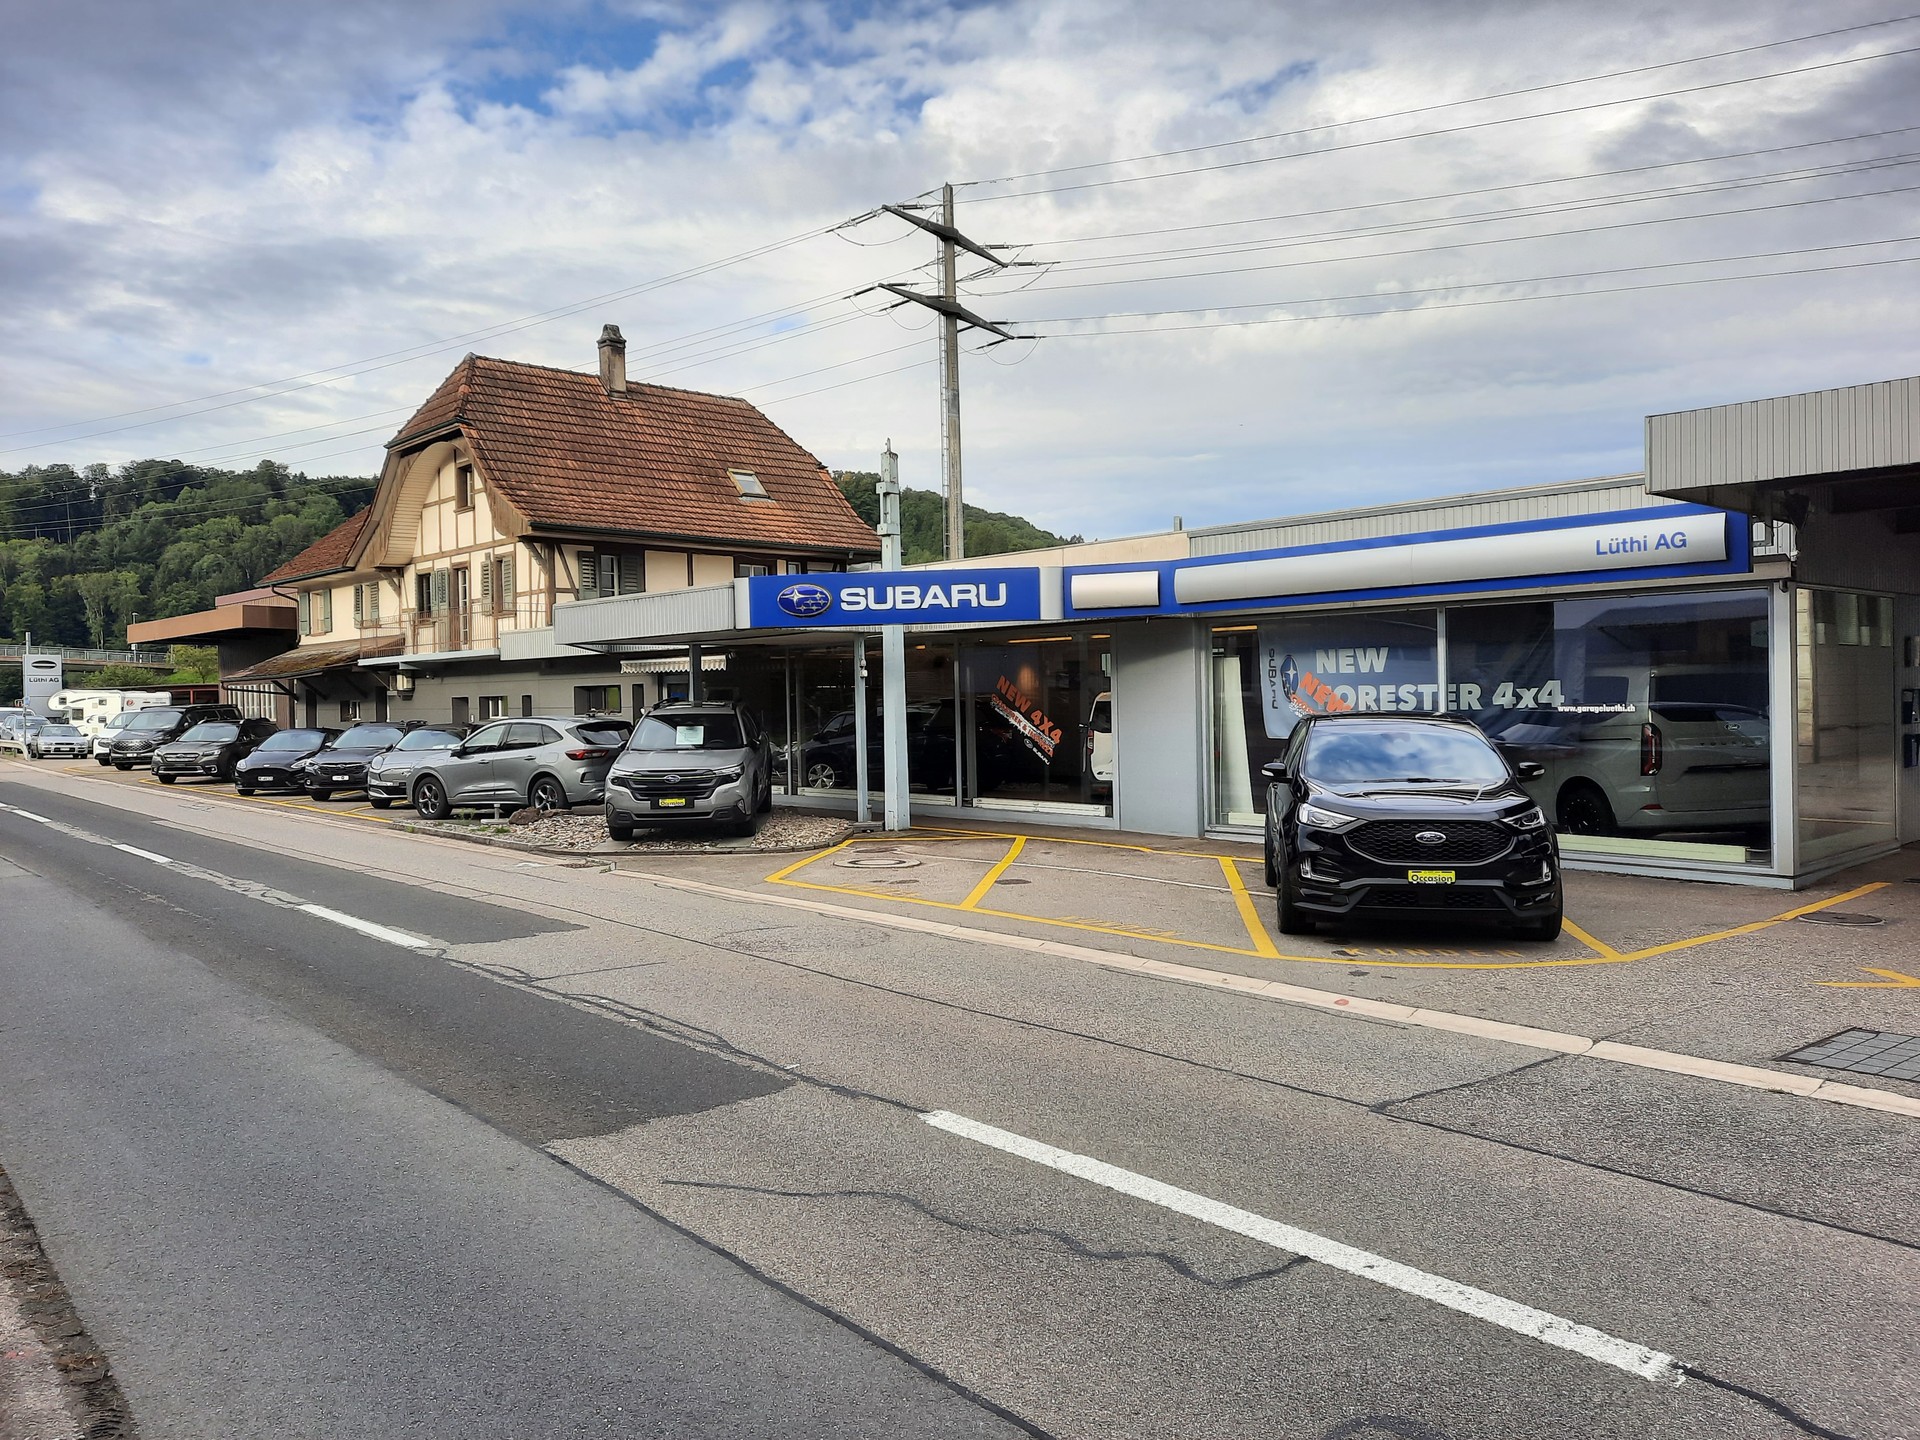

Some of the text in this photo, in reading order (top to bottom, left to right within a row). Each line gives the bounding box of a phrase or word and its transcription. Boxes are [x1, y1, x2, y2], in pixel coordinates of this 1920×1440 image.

[1596, 532, 1687, 555] Lüthi AG
[840, 583, 1007, 611] SUBARU
[1315, 647, 1389, 674] NEW
[996, 675, 1031, 713] NEW
[1492, 680, 1565, 709] 4x4
[1411, 874, 1453, 882] Occasion
